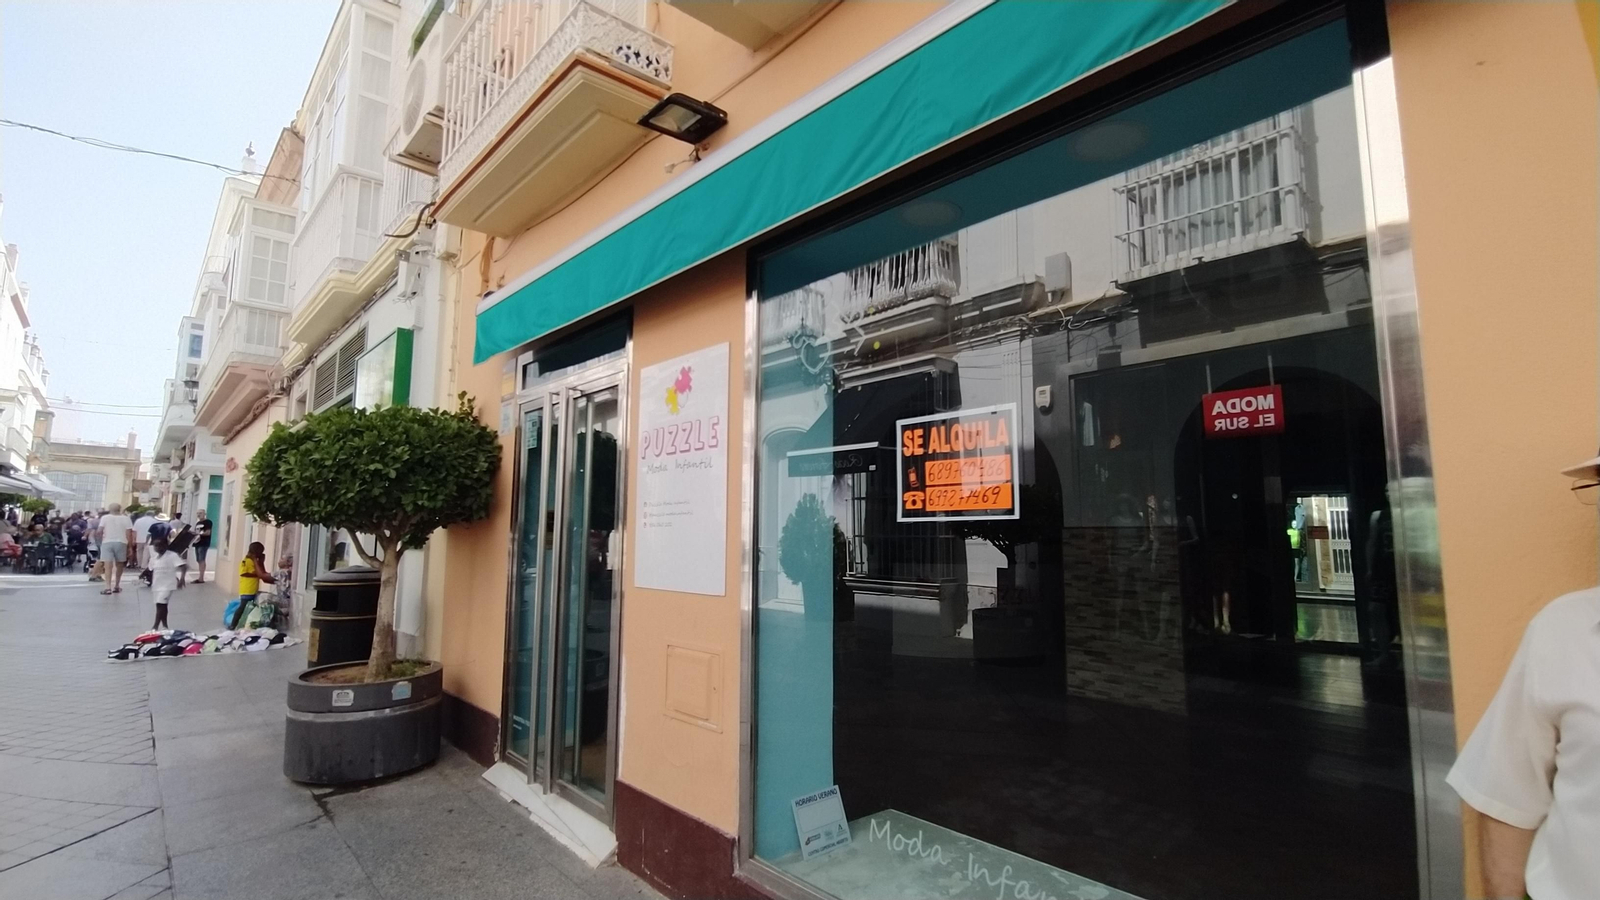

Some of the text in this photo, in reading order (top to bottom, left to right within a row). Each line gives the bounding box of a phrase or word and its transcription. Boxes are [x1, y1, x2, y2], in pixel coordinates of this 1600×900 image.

[640, 414, 721, 460] PUZZLE
[902, 417, 1010, 457] SE ALQUILA
[646, 456, 714, 474] Moda Infantil
[794, 788, 838, 808] HORARIO VERANO
[868, 817, 952, 866] Moda
